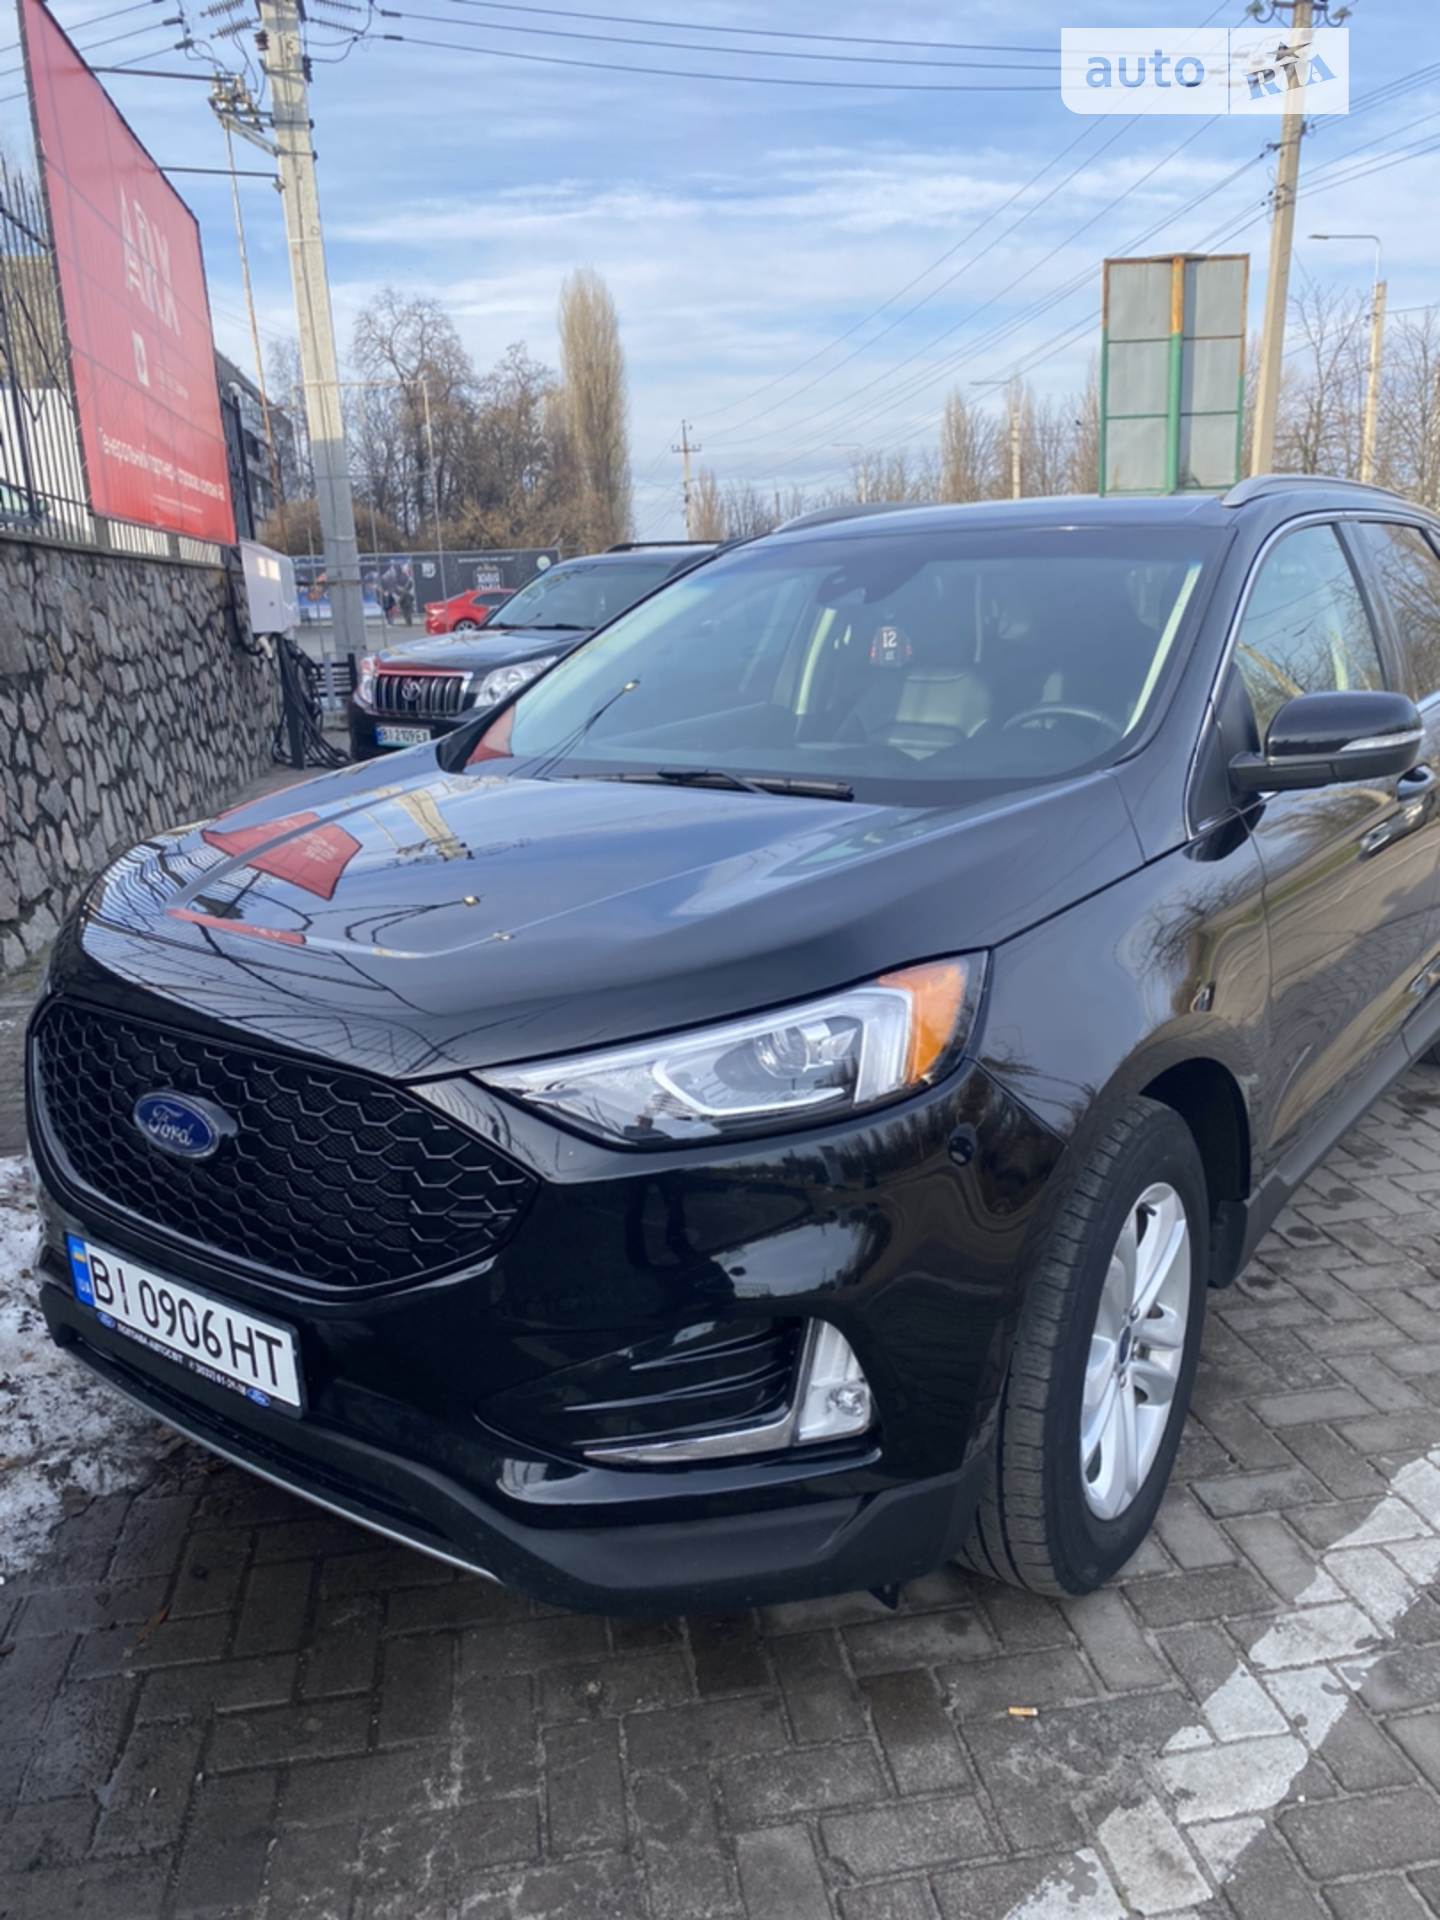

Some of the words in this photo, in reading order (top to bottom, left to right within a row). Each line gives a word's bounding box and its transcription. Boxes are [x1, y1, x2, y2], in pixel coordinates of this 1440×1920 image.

[882, 630, 897, 648] 12
[147, 1103, 195, 1147] Ford
[137, 1279, 223, 1359] 0906
